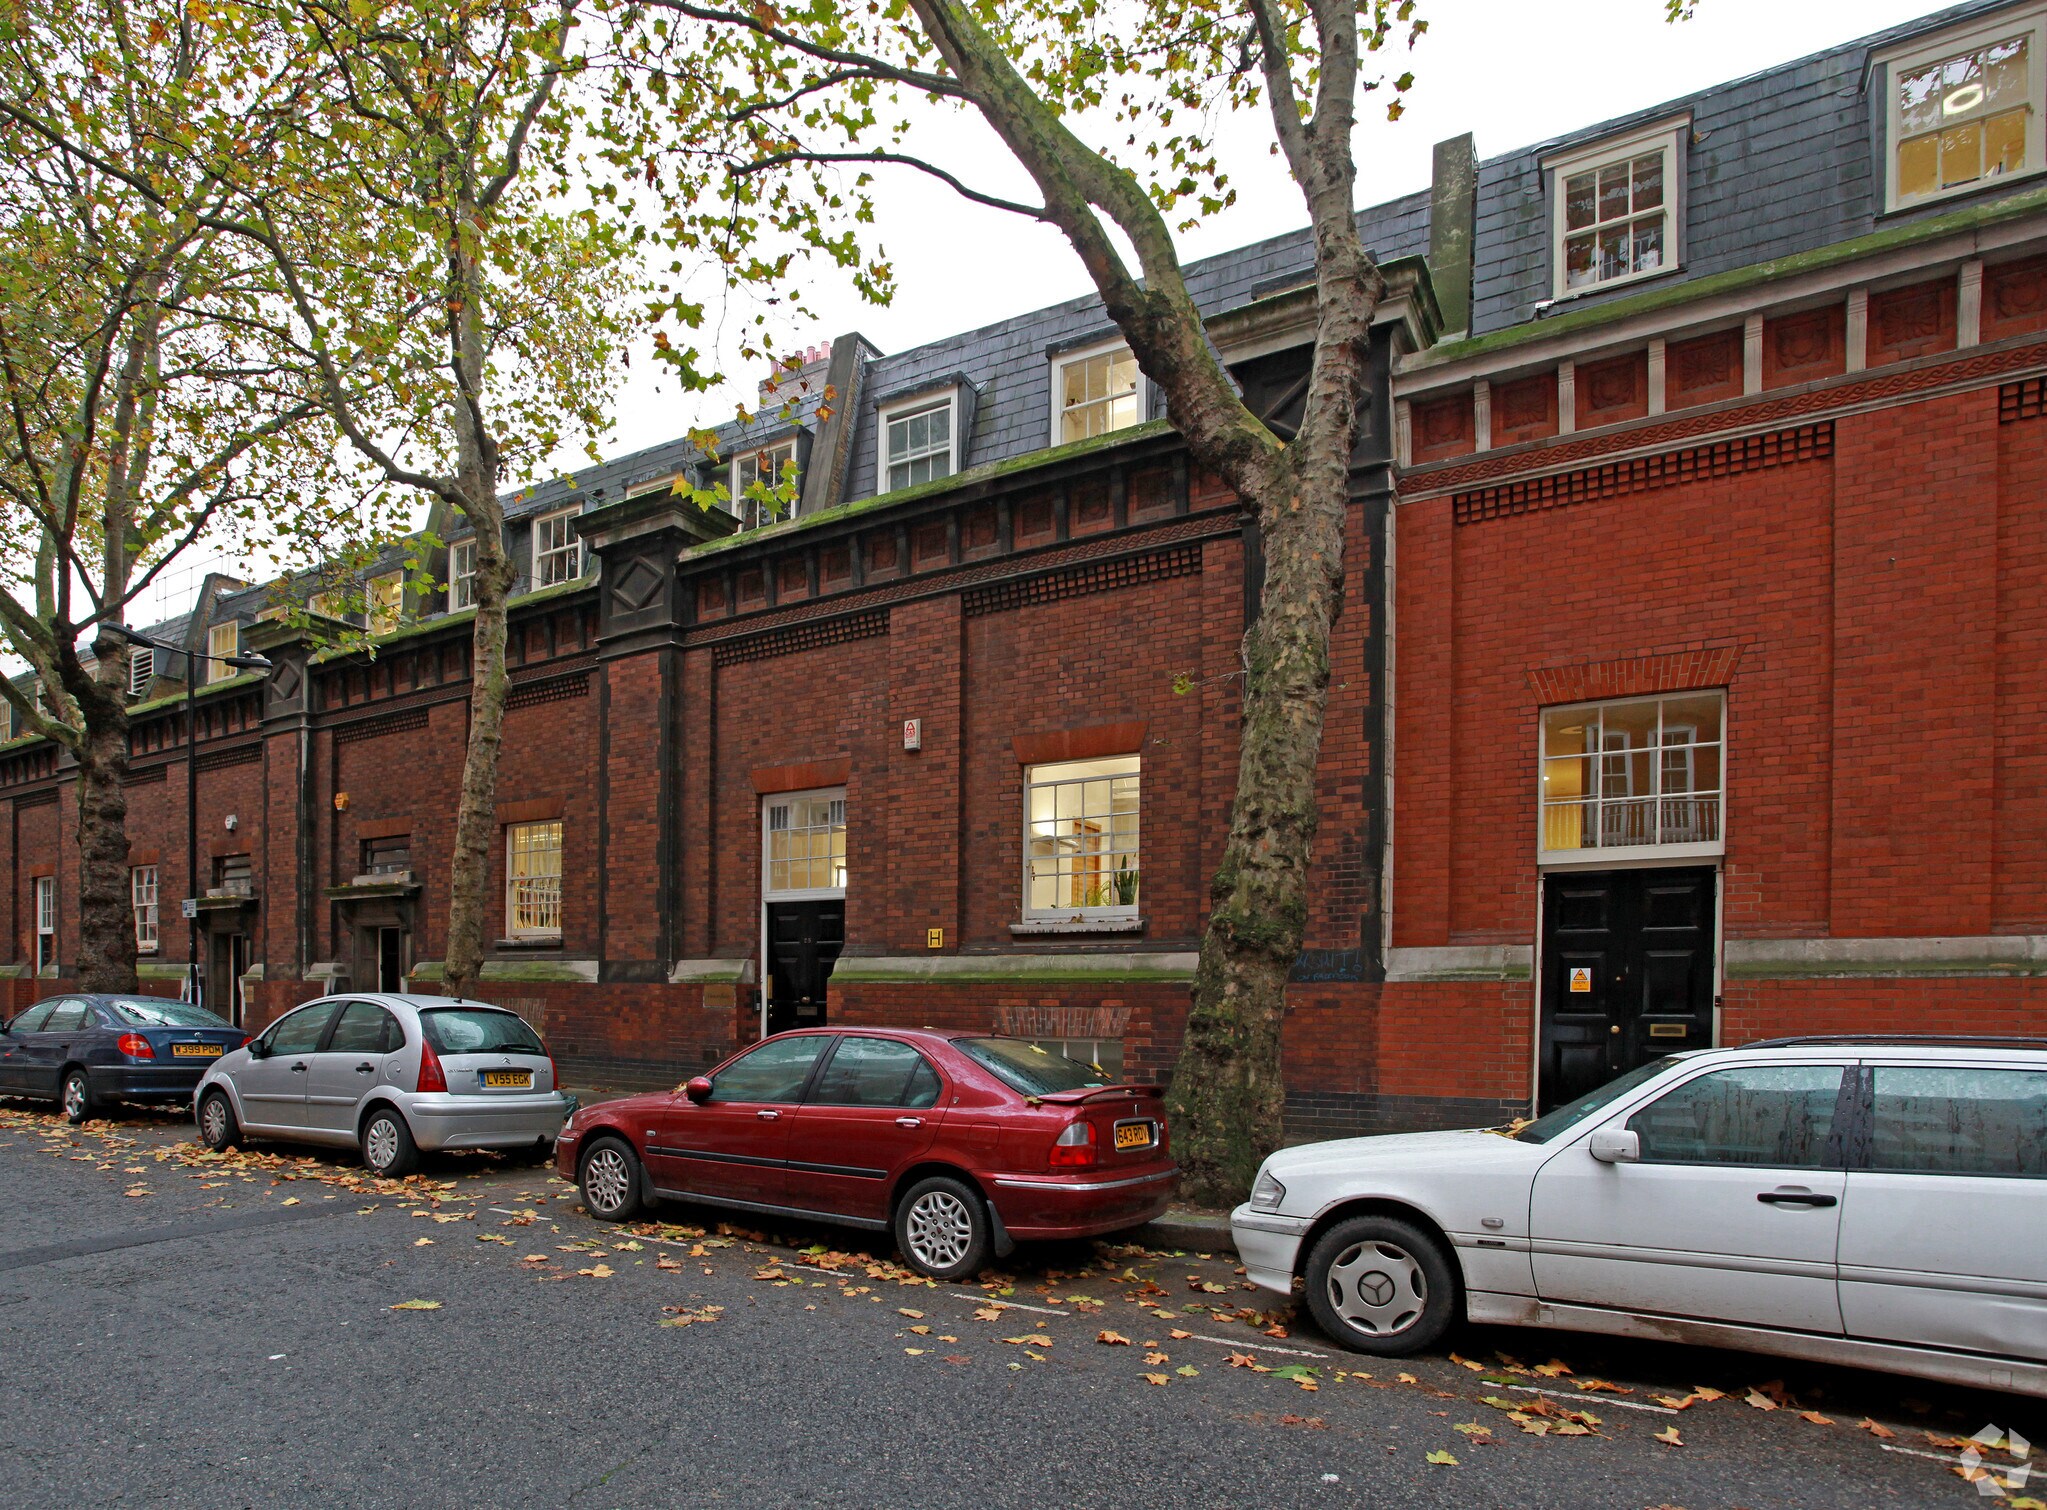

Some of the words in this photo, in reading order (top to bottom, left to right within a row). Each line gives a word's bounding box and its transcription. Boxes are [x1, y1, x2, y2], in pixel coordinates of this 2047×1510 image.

[930, 930, 941, 946] H
[175, 1045, 201, 1054] W399
[486, 1073, 512, 1085] LV55
[512, 1073, 530, 1084] EGK
[1115, 1126, 1134, 1145] 643
